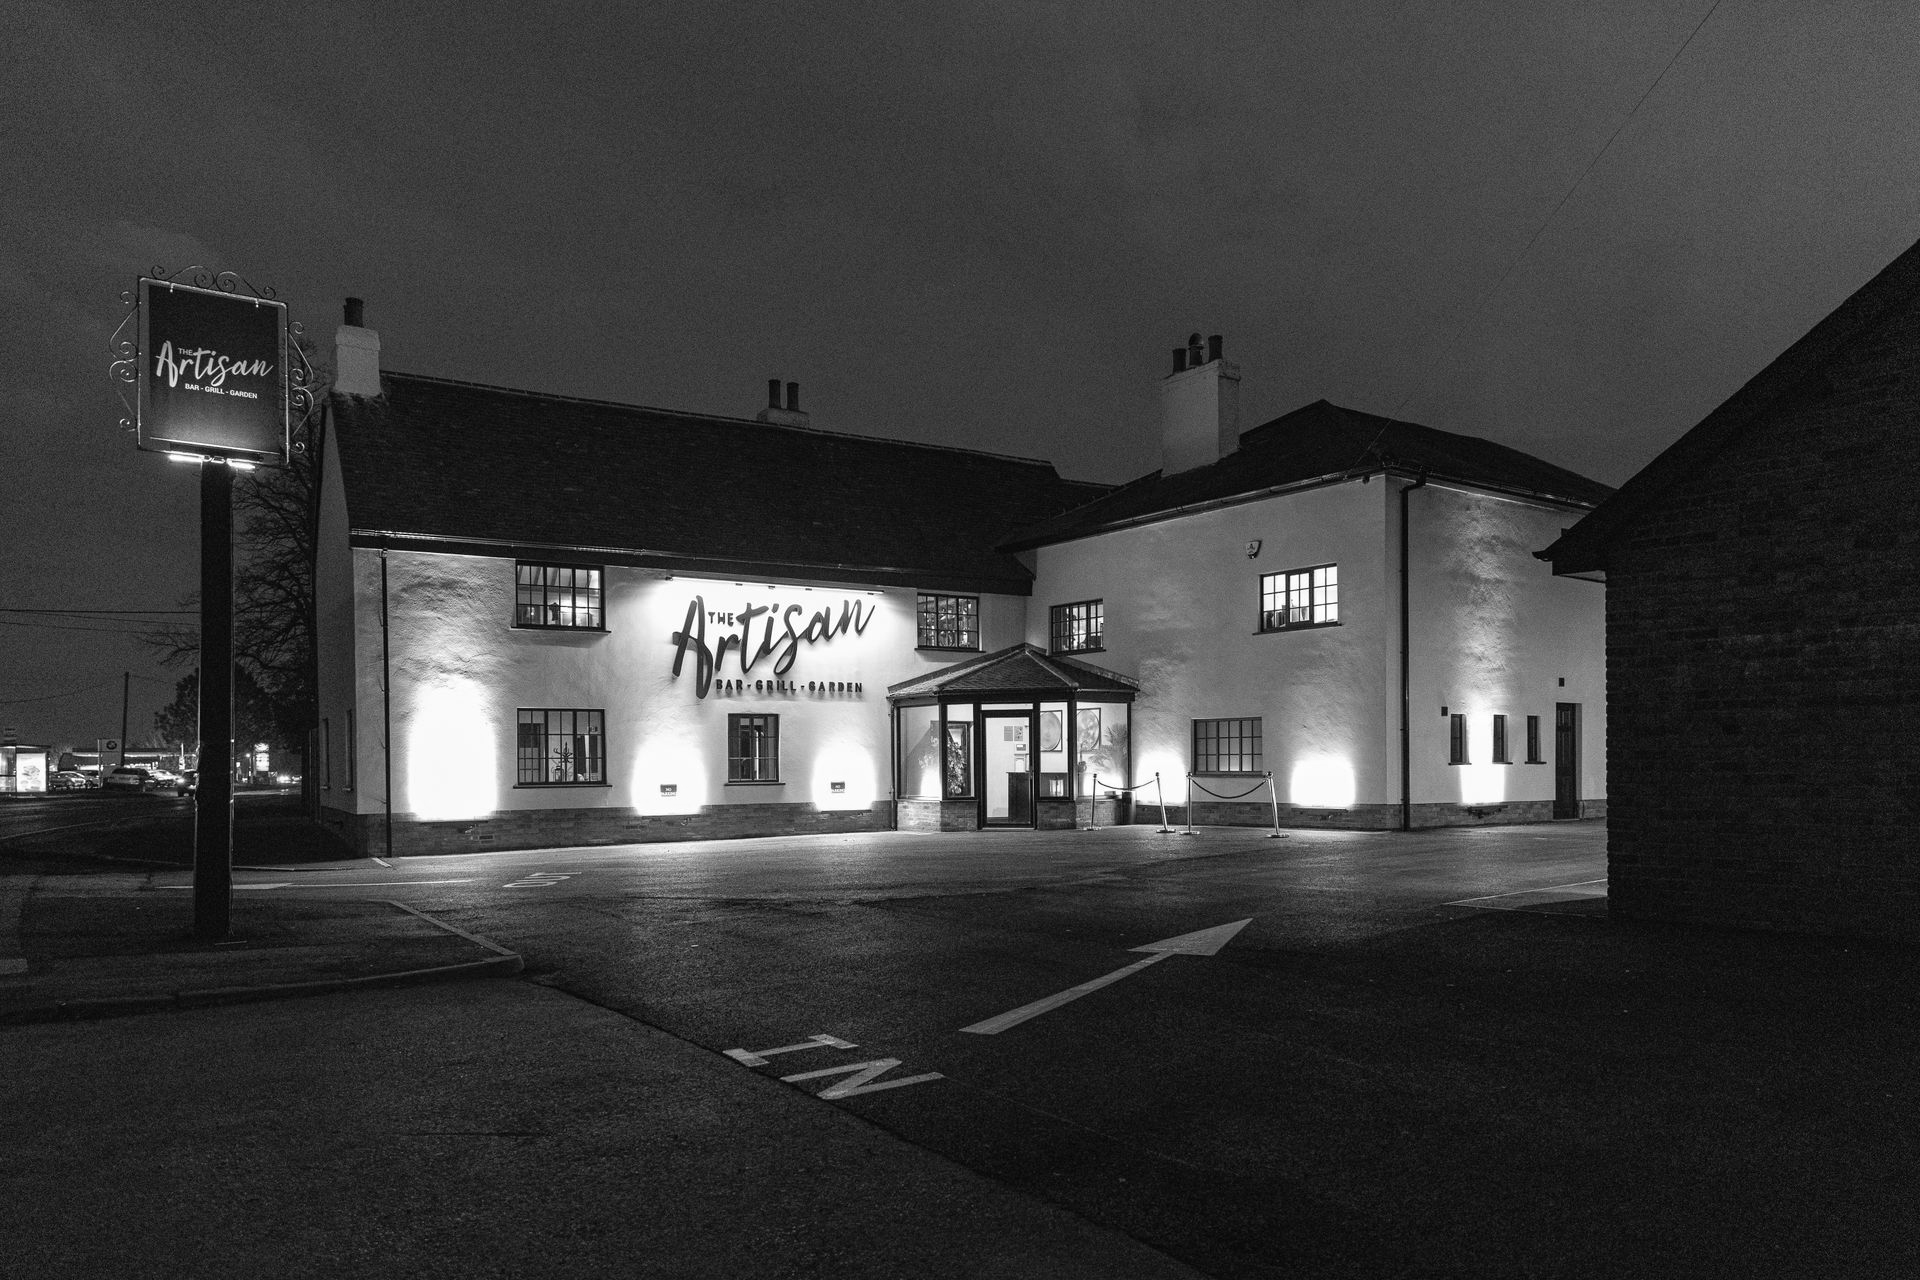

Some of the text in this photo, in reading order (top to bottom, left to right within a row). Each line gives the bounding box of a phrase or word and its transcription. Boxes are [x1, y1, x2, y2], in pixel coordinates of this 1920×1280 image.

[178, 347, 192, 355] THE
[156, 340, 274, 387] Artisan
[185, 383, 199, 391] BAR
[205, 386, 225, 395] GRILL
[230, 389, 258, 399] GARDEN
[708, 612, 734, 627] THE
[672, 595, 876, 699] Artisan
[716, 679, 743, 691] BAR
[755, 680, 797, 692] GRILL
[809, 681, 863, 693] GARDEN
[722, 1033, 945, 1100] IN
